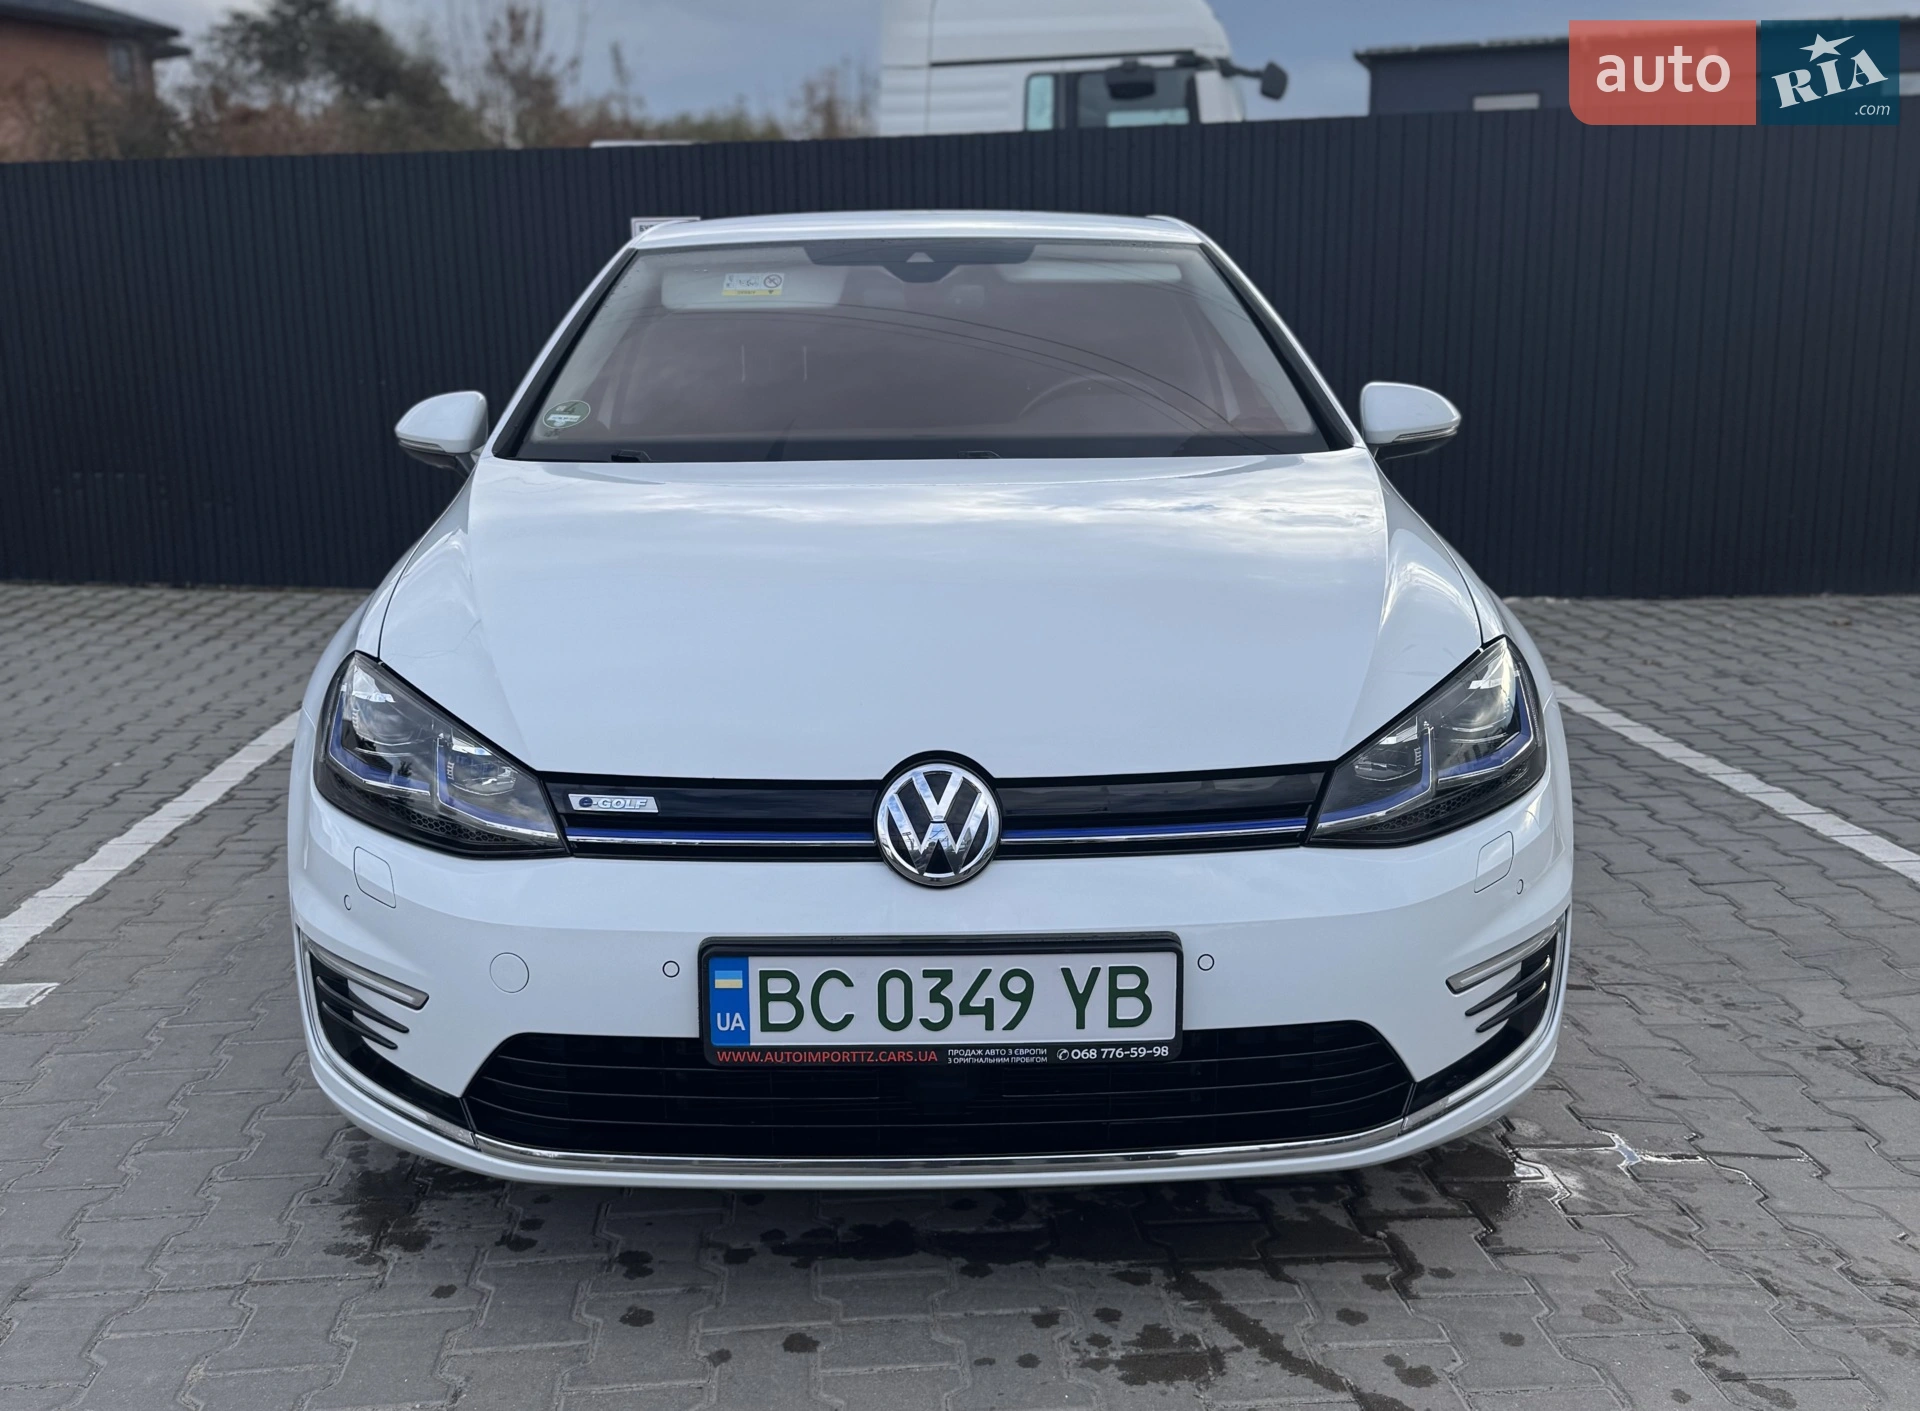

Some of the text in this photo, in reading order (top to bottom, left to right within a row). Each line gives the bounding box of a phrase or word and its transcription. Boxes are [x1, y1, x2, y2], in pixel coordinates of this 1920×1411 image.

[758, 965, 1153, 1032] BC 0349 YB
[716, 1012, 746, 1031] UA
[716, 1050, 938, 1063] WWW.AUTOIMPORTTZ.CARS.UA
[948, 1049, 983, 1057] ПРОДАЖ
[985, 1048, 1006, 1056] АВТО
[1014, 1048, 1047, 1056] ЄВРОПИ
[1071, 1046, 1169, 1060] 068 776-59-98
